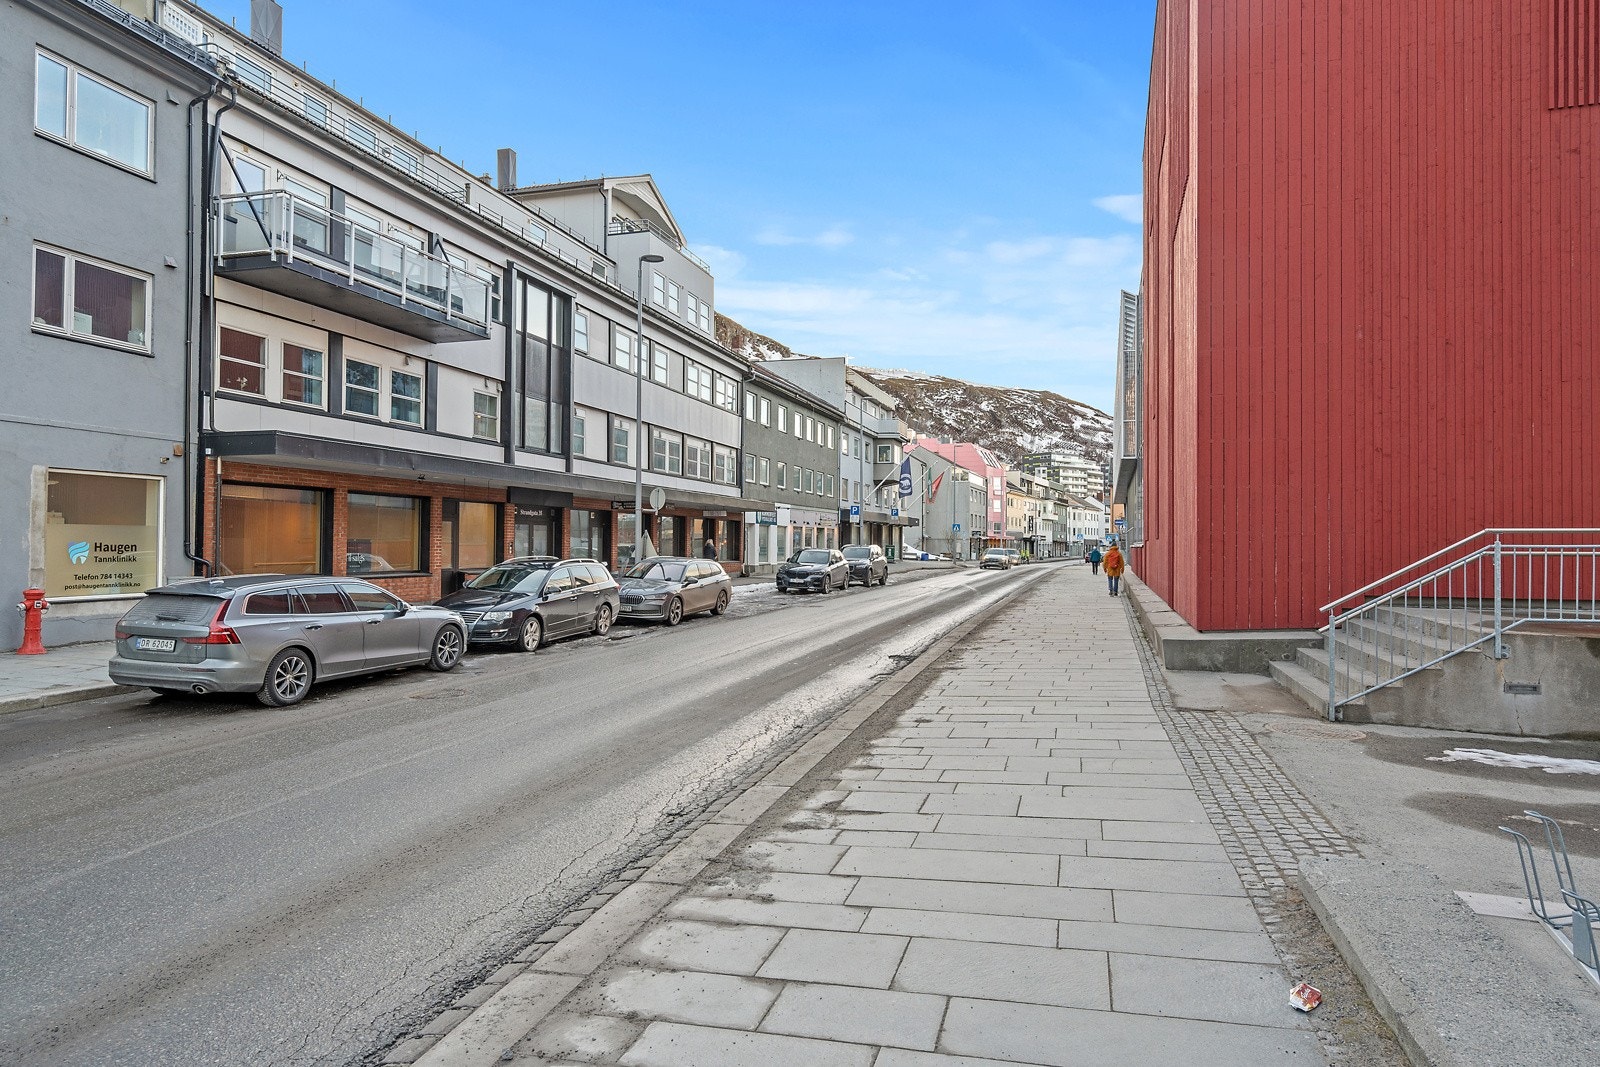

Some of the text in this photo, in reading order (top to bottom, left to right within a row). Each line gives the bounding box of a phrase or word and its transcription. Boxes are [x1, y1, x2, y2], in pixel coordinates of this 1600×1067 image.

[94, 542, 137, 554] Haugen
[64, 582, 140, 590] post@haugentannklinikk.no
[152, 640, 173, 649] 62045
